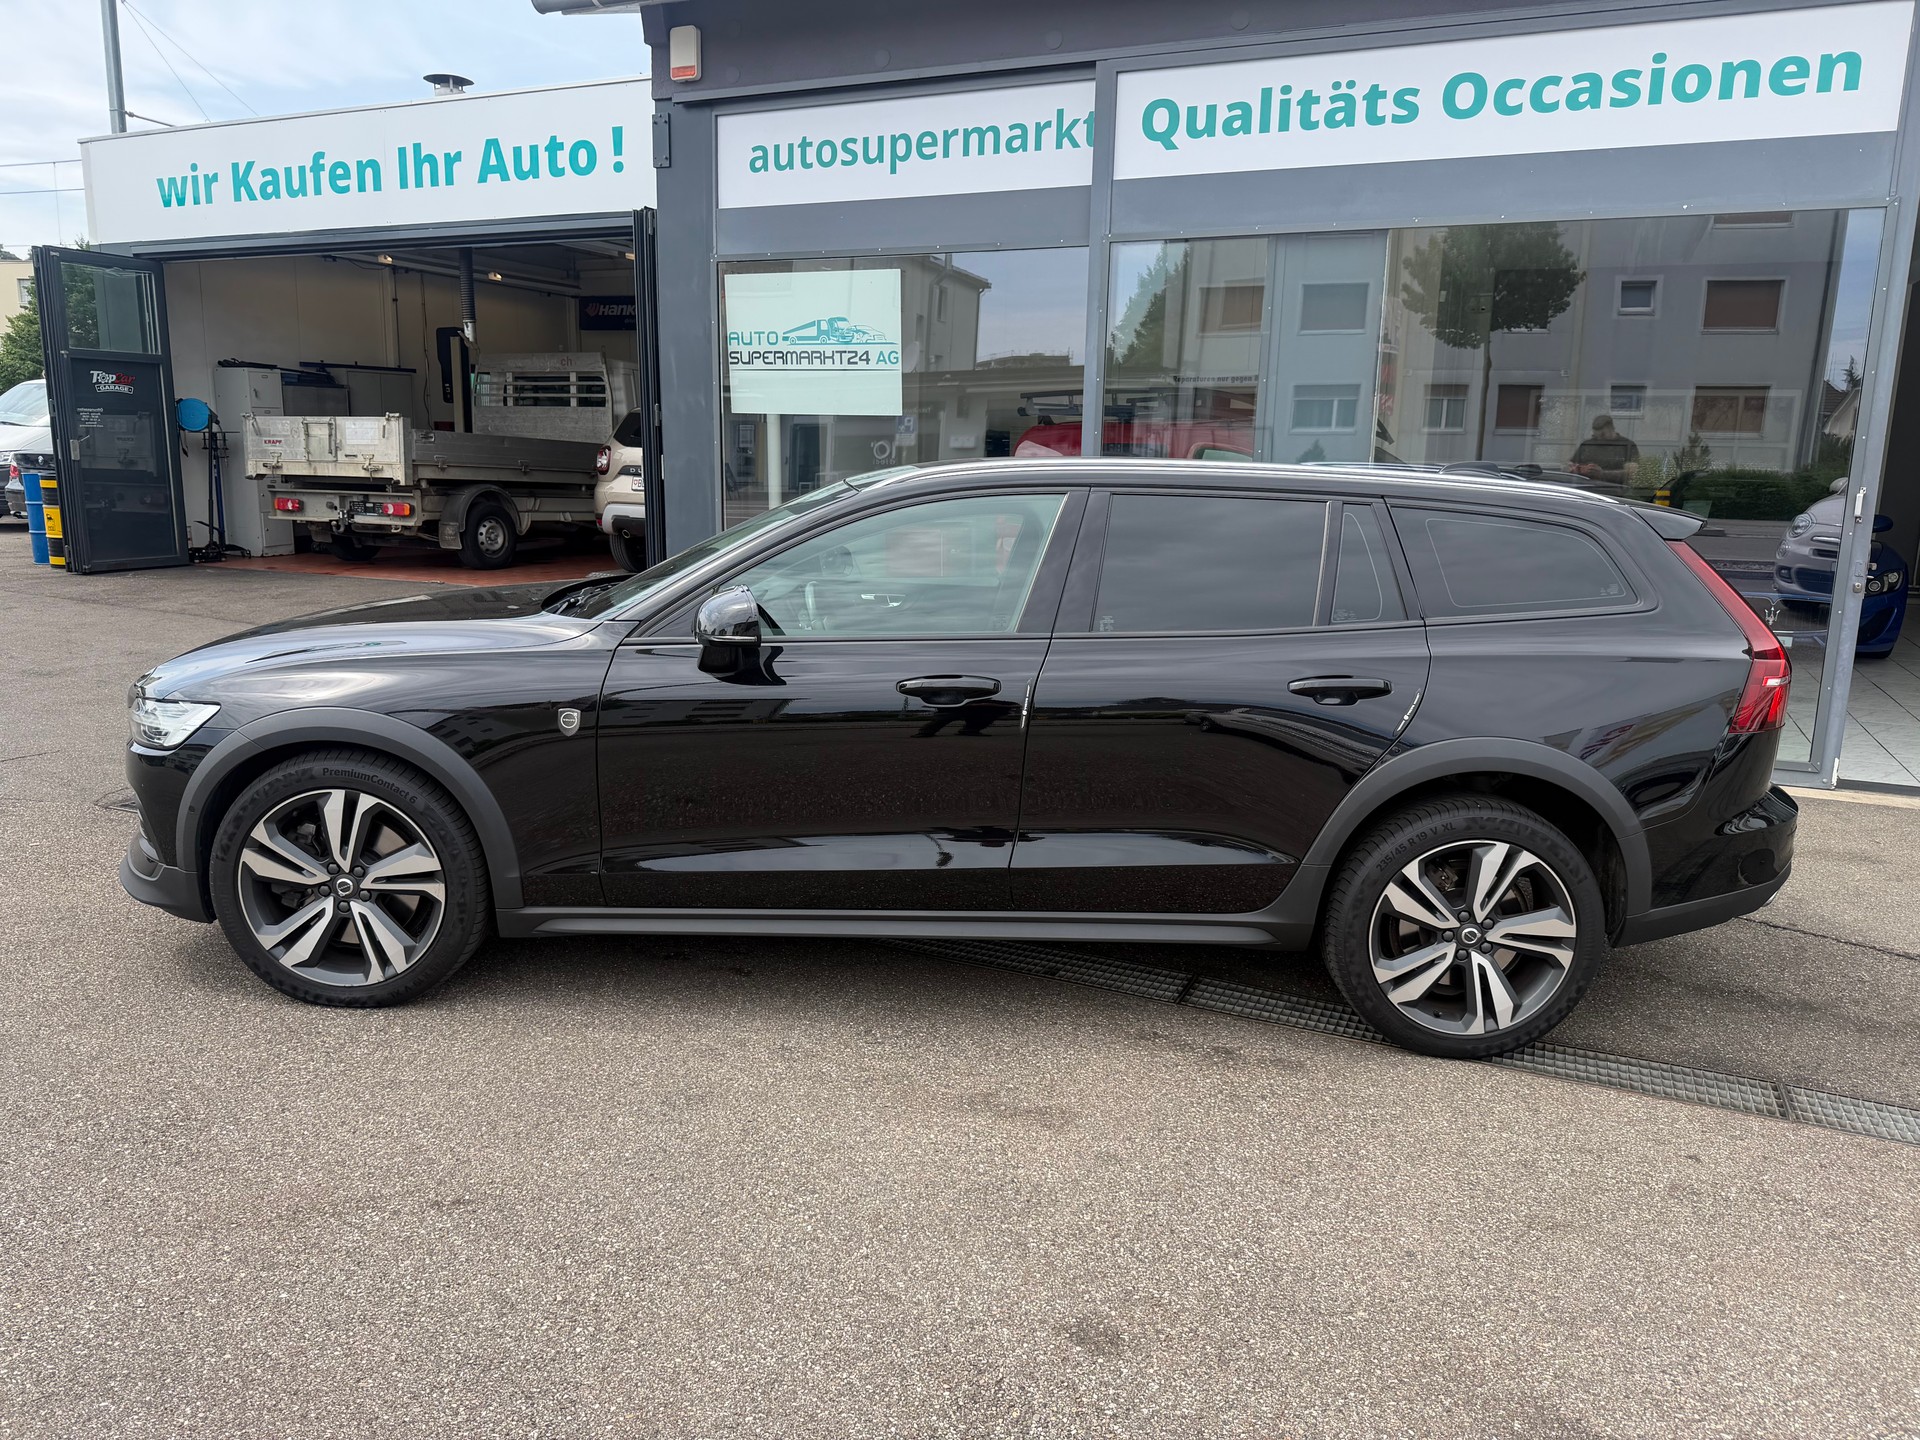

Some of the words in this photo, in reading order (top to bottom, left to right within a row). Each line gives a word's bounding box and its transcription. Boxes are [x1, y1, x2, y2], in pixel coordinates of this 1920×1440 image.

[1142, 80, 1420, 151] Qualitäts
[1442, 51, 1862, 120] Occasionen
[749, 108, 1095, 175] autosupermarkt
[156, 162, 219, 209] wir
[231, 151, 382, 203] Kaufen
[397, 142, 463, 190] Ihr
[477, 135, 598, 184] Auto
[611, 126, 625, 174] !
[728, 331, 779, 346] AUTO
[728, 350, 871, 366] SUPERMARKT24
[875, 350, 900, 365] AG
[1172, 375, 1217, 384] Reparaturen
[1230, 375, 1253, 383] gegen
[322, 768, 410, 801] PremiumContact
[409, 795, 418, 804] 6
[1376, 843, 1407, 872] 235/45
[1407, 837, 1417, 847] R
[1415, 831, 1428, 842] 19
[1429, 826, 1438, 836] V
[1441, 822, 1456, 833] XL
